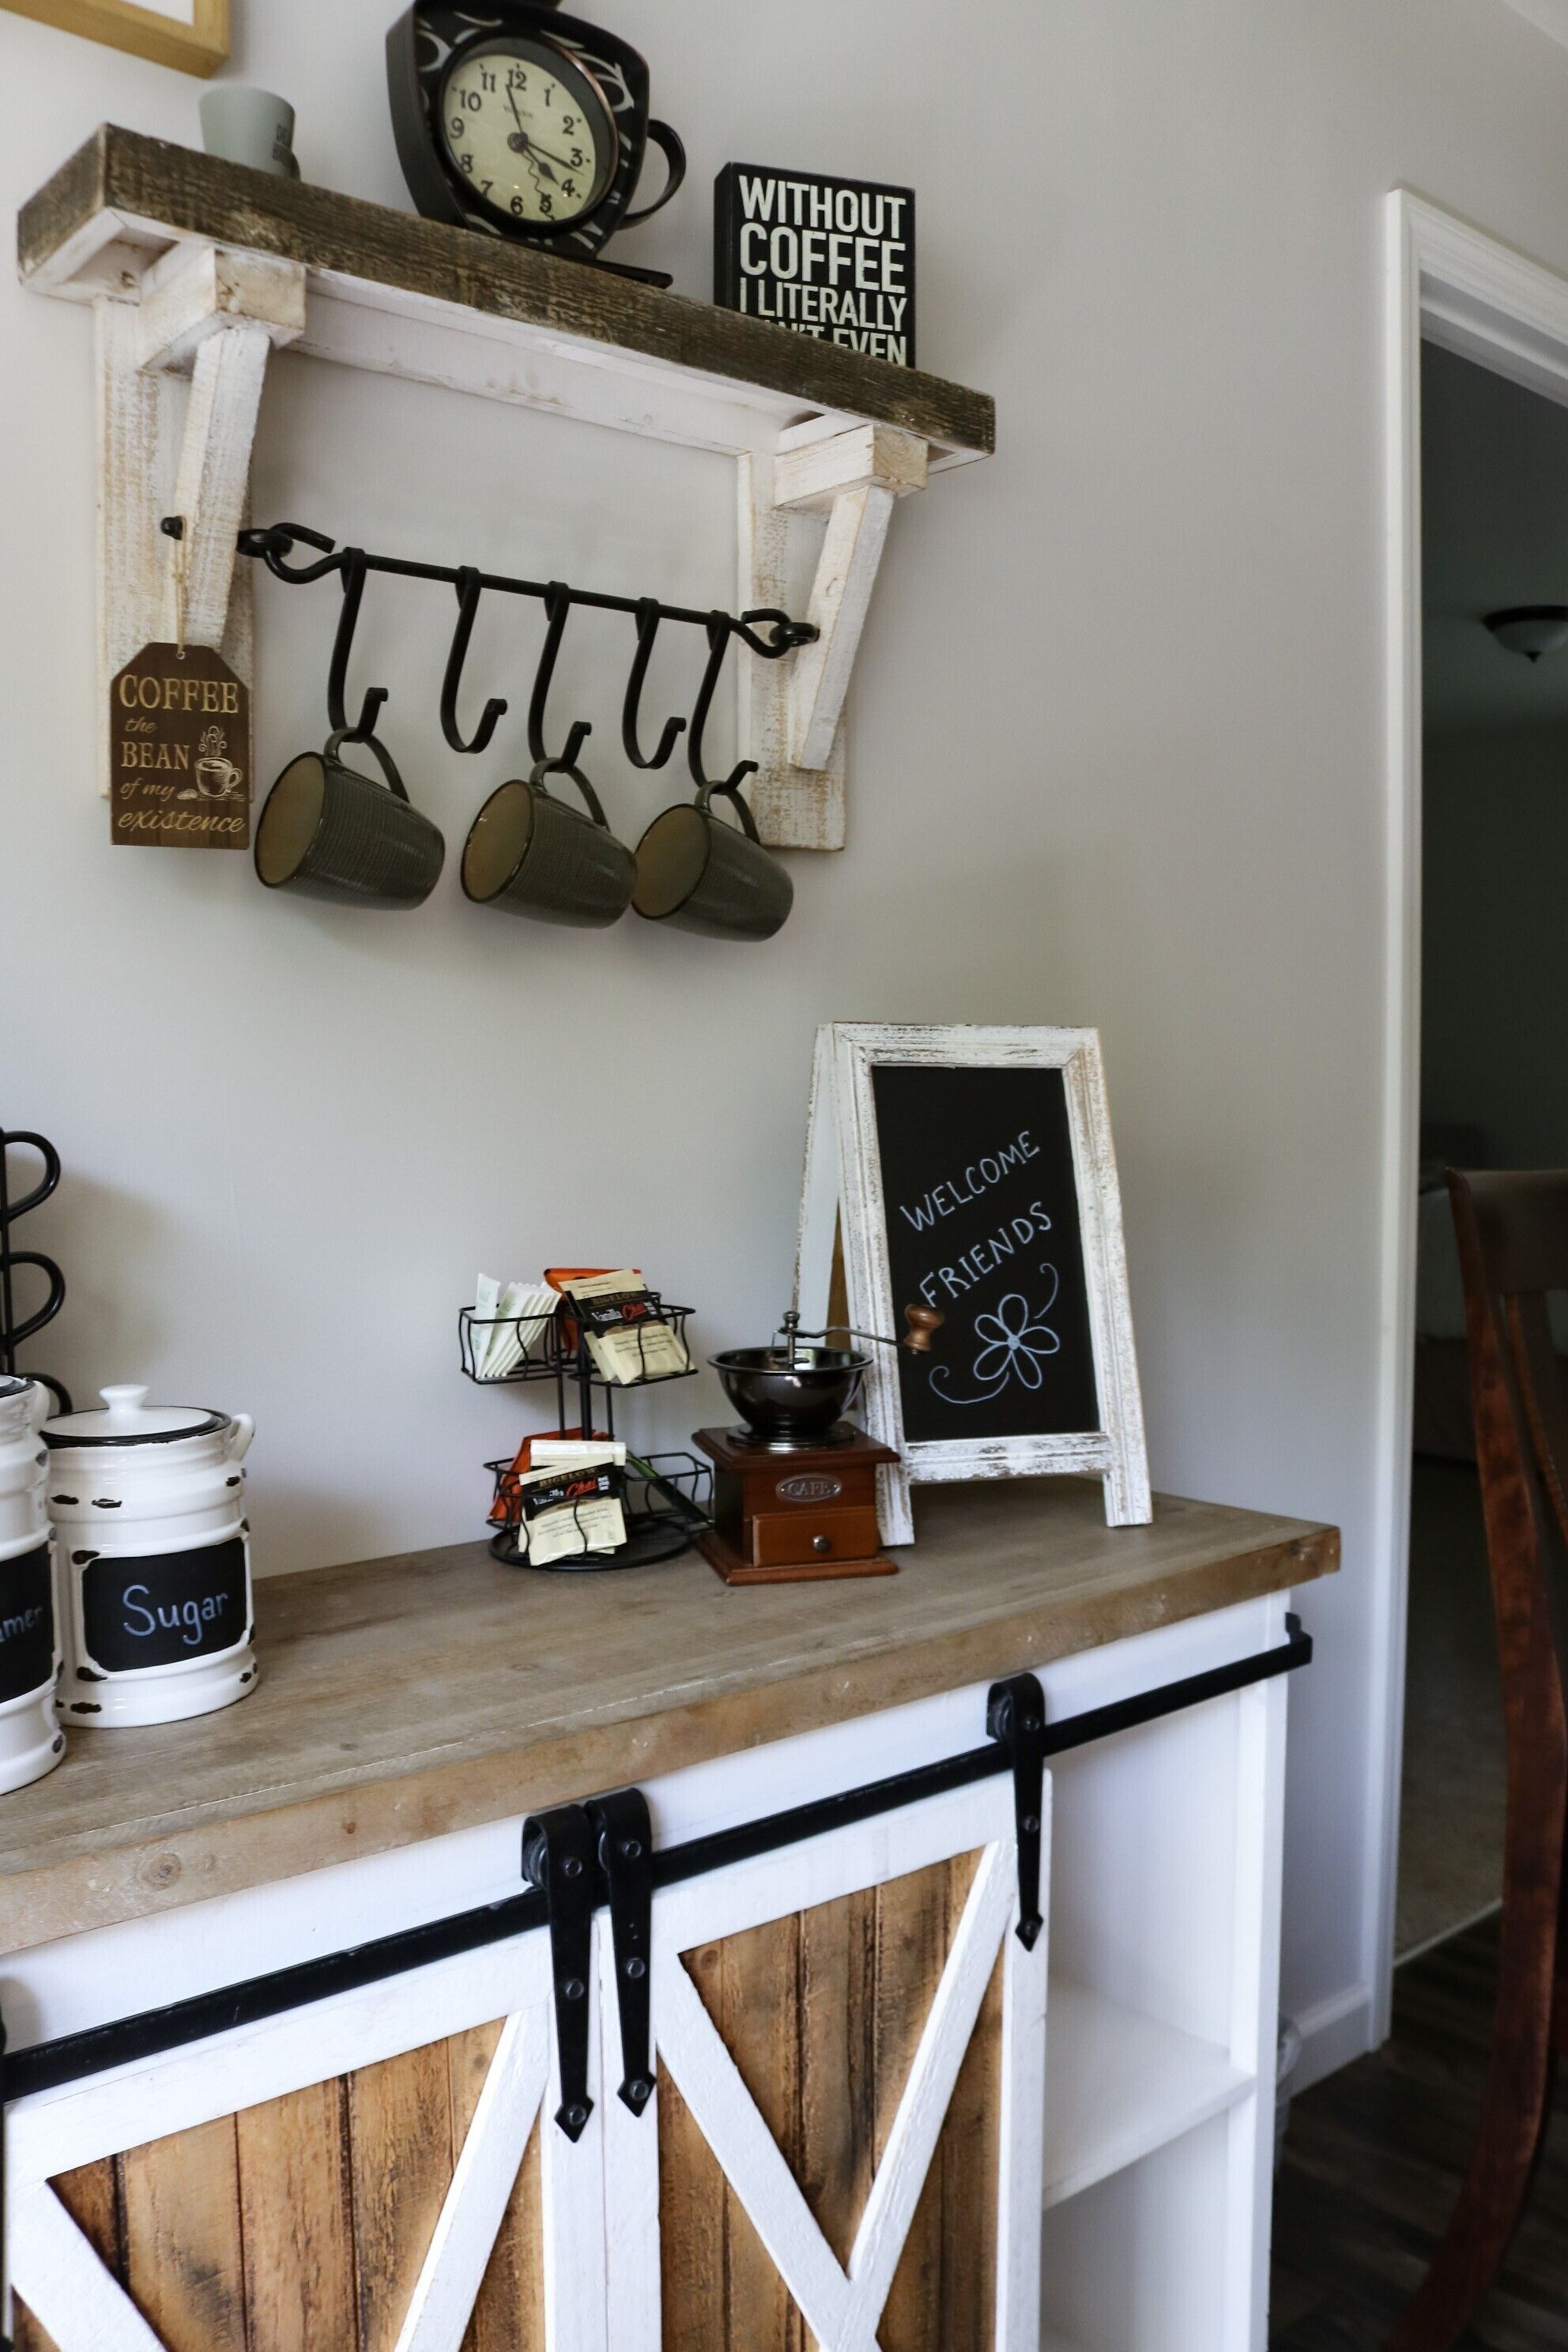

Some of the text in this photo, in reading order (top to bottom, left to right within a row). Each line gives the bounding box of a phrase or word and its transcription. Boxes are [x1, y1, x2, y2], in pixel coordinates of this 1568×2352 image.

[481, 71, 496, 92] 11
[507, 70, 526, 92] 12
[459, 89, 482, 111] 10
[544, 88, 551, 107] 1
[450, 118, 465, 139] 9
[562, 115, 575, 135] 2
[460, 153, 474, 174] 8
[570, 148, 583, 168] 3
[481, 179, 493, 195] 7
[560, 179, 575, 198] 4
[510, 196, 523, 216] 6
[738, 175, 906, 239] WITHOUT
[740, 222, 906, 294] COFFEE
[740, 277, 748, 313] I
[757, 279, 907, 332] LITERALLY
[119, 673, 239, 714] COFFEE
[125, 716, 156, 733] the
[121, 741, 190, 771] BEAN
[119, 777, 175, 802] of my
[118, 809, 246, 833] existence
[899, 1130, 1041, 1232] WELCOME
[918, 1200, 1053, 1309] FRIENDS
[122, 1584, 228, 1645] Sugar
